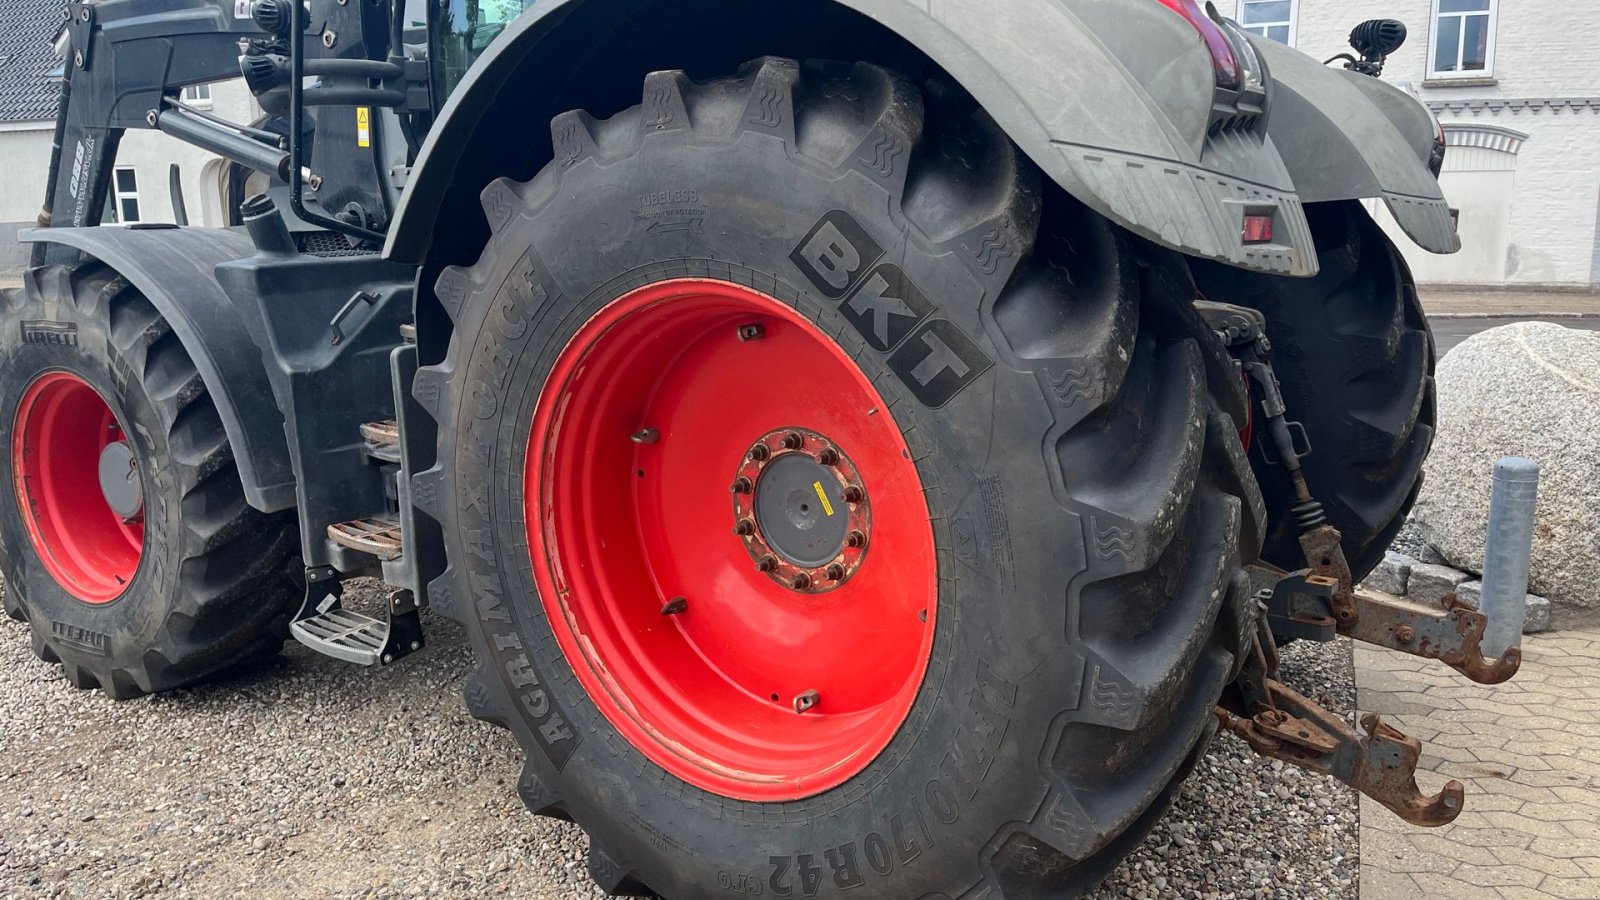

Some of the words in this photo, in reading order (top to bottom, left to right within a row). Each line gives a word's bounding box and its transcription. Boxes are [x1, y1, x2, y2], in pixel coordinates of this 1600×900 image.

[634, 189, 699, 208] TUBELESS
[20, 320, 79, 347] PIRELLI
[465, 254, 549, 470] FORCE
[796, 218, 975, 392] BKT
[459, 478, 575, 748] AGRIMAX
